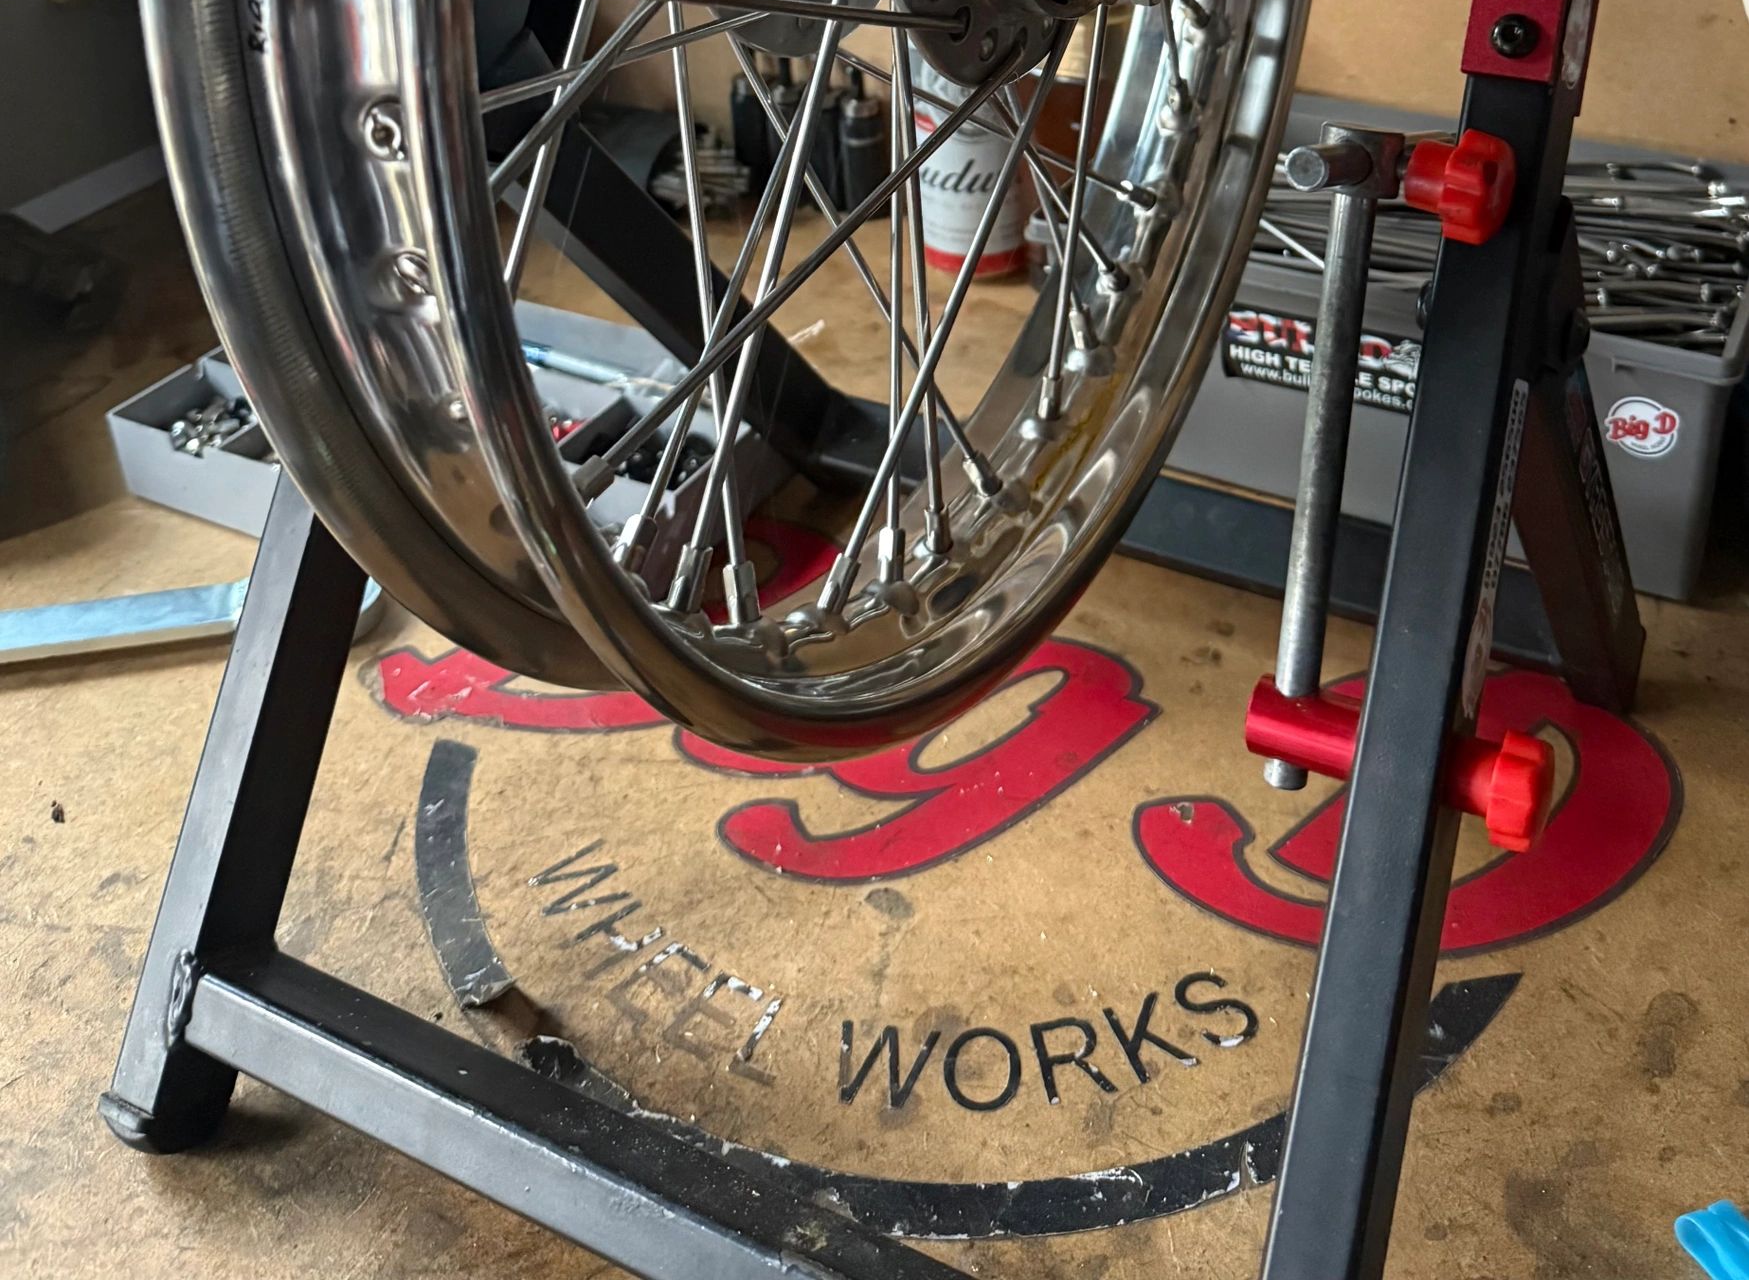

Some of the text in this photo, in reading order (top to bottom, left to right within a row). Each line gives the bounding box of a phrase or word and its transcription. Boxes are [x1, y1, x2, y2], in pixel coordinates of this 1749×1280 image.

[1229, 344, 1282, 368] HIGH
[1609, 411, 1677, 440] Big D
[837, 970, 1260, 1114] WORKS
